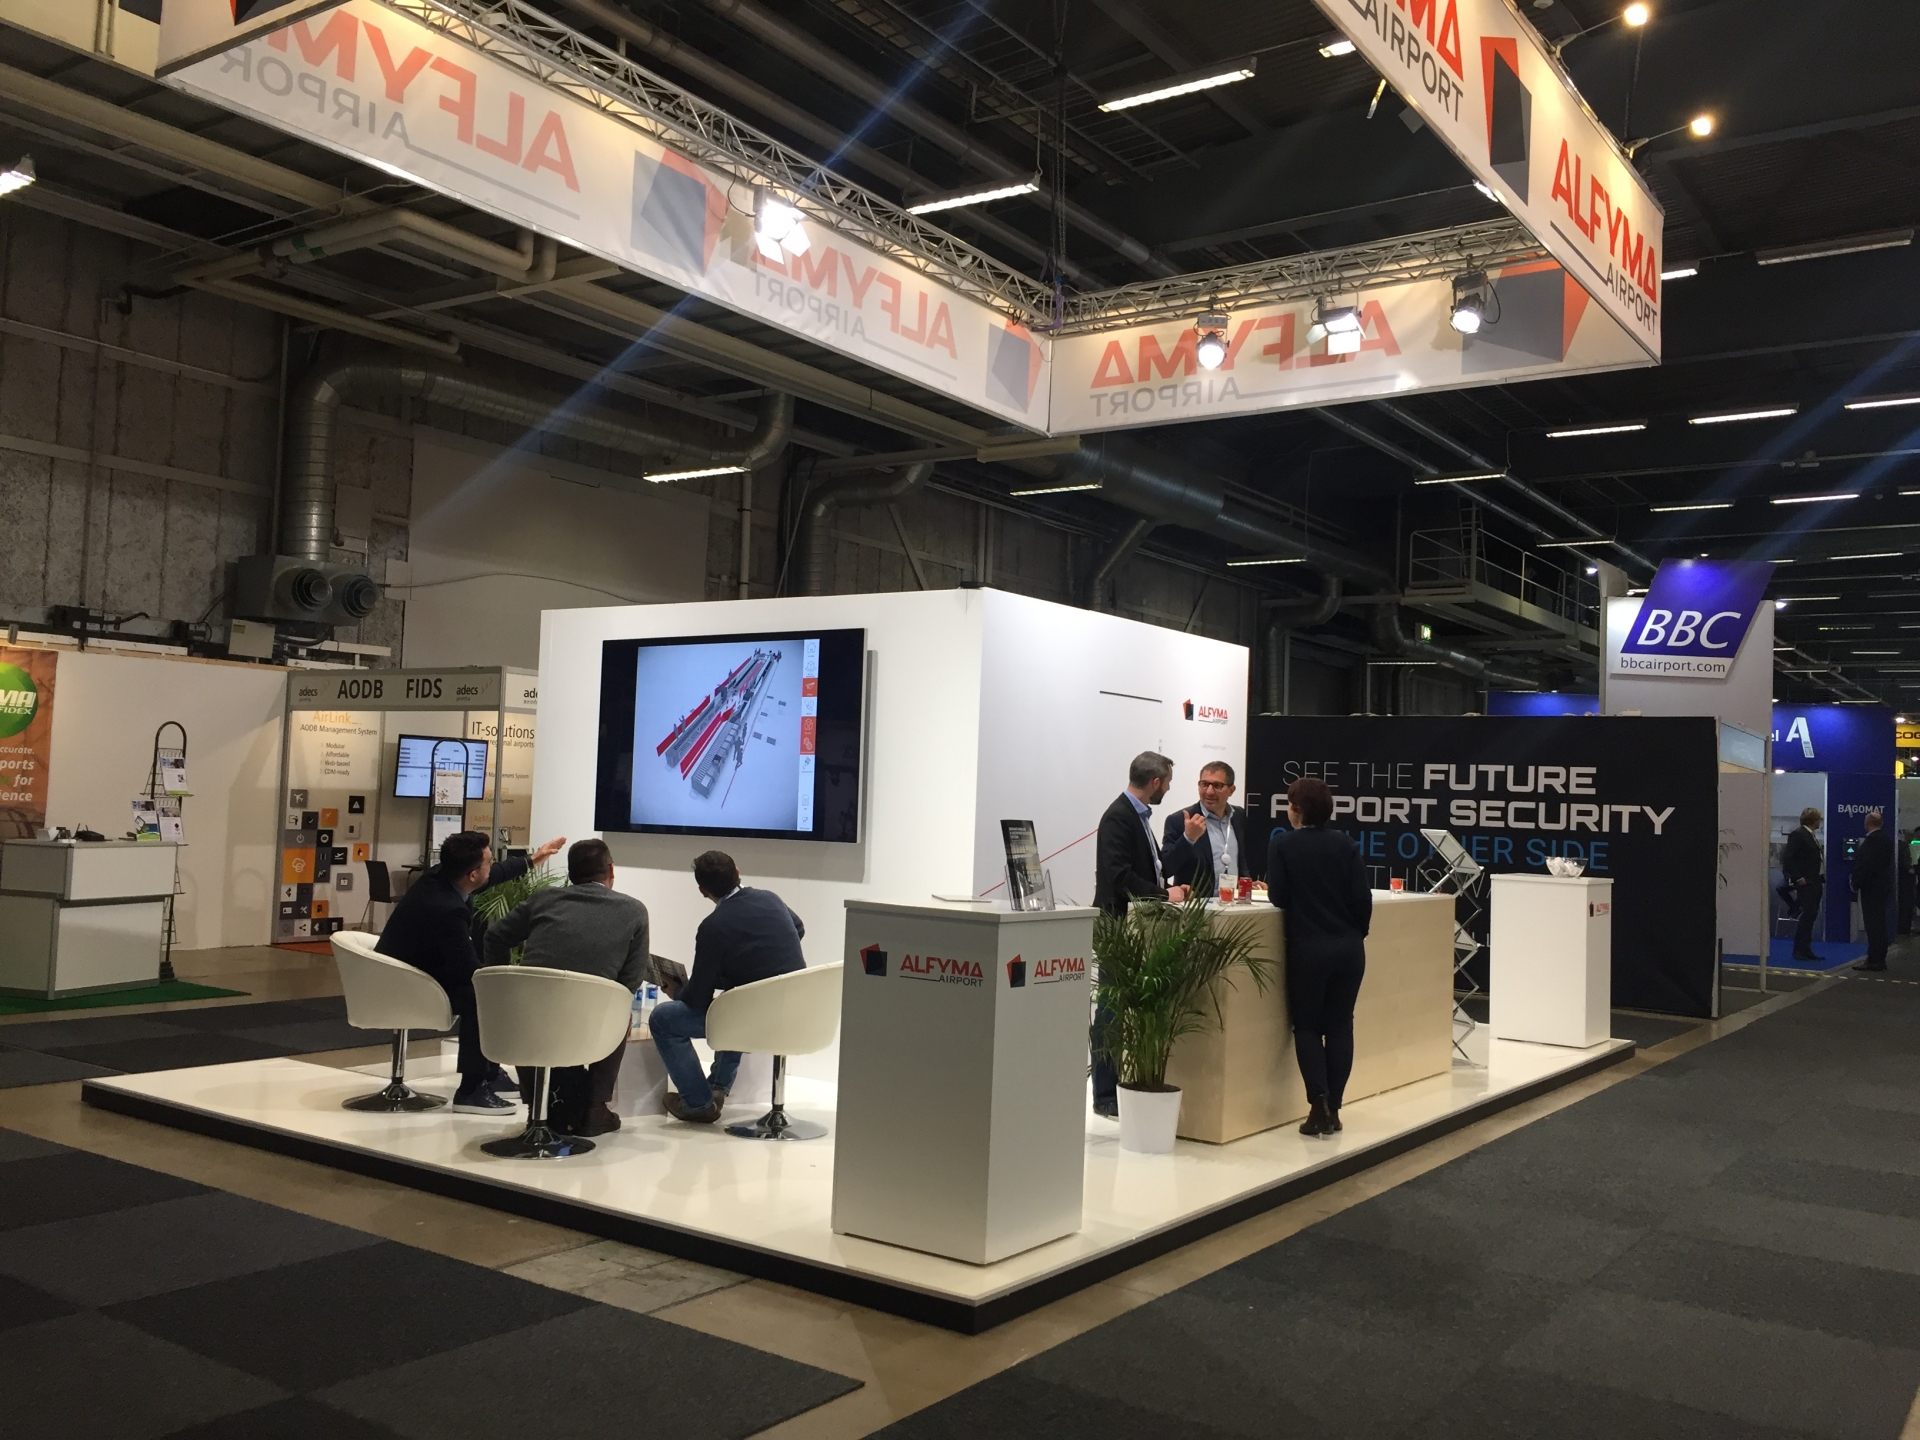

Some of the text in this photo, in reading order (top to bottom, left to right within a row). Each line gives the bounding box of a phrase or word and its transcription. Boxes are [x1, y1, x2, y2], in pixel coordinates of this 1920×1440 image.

[1364, 0, 1463, 122] AIRPORT
[1551, 137, 1657, 304] ALFYMA
[1605, 262, 1657, 335] AIRPORT
[1636, 609, 1741, 649] BBC
[1620, 657, 1726, 673] bbcairport.com
[299, 686, 318, 696] adecs
[337, 678, 442, 699] AODB FIDS
[456, 684, 478, 695] adecs
[1198, 706, 1228, 719] ALFYMA
[319, 725, 357, 735] Management
[358, 727, 377, 736] System
[513, 740, 535, 749] airports
[13, 774, 34, 787] for
[1283, 760, 1597, 794] SEE THE FUTURE
[1270, 794, 1438, 825] APORT
[1449, 799, 1676, 835] SECURITY
[1838, 804, 1885, 817] BAGOMAT
[1526, 838, 1609, 870] SIDE
[900, 954, 984, 978] ALFYMA
[1034, 957, 1085, 978] ALFYMA
[938, 975, 984, 988] AIRPORT
[1058, 972, 1085, 982] AIRPORT
